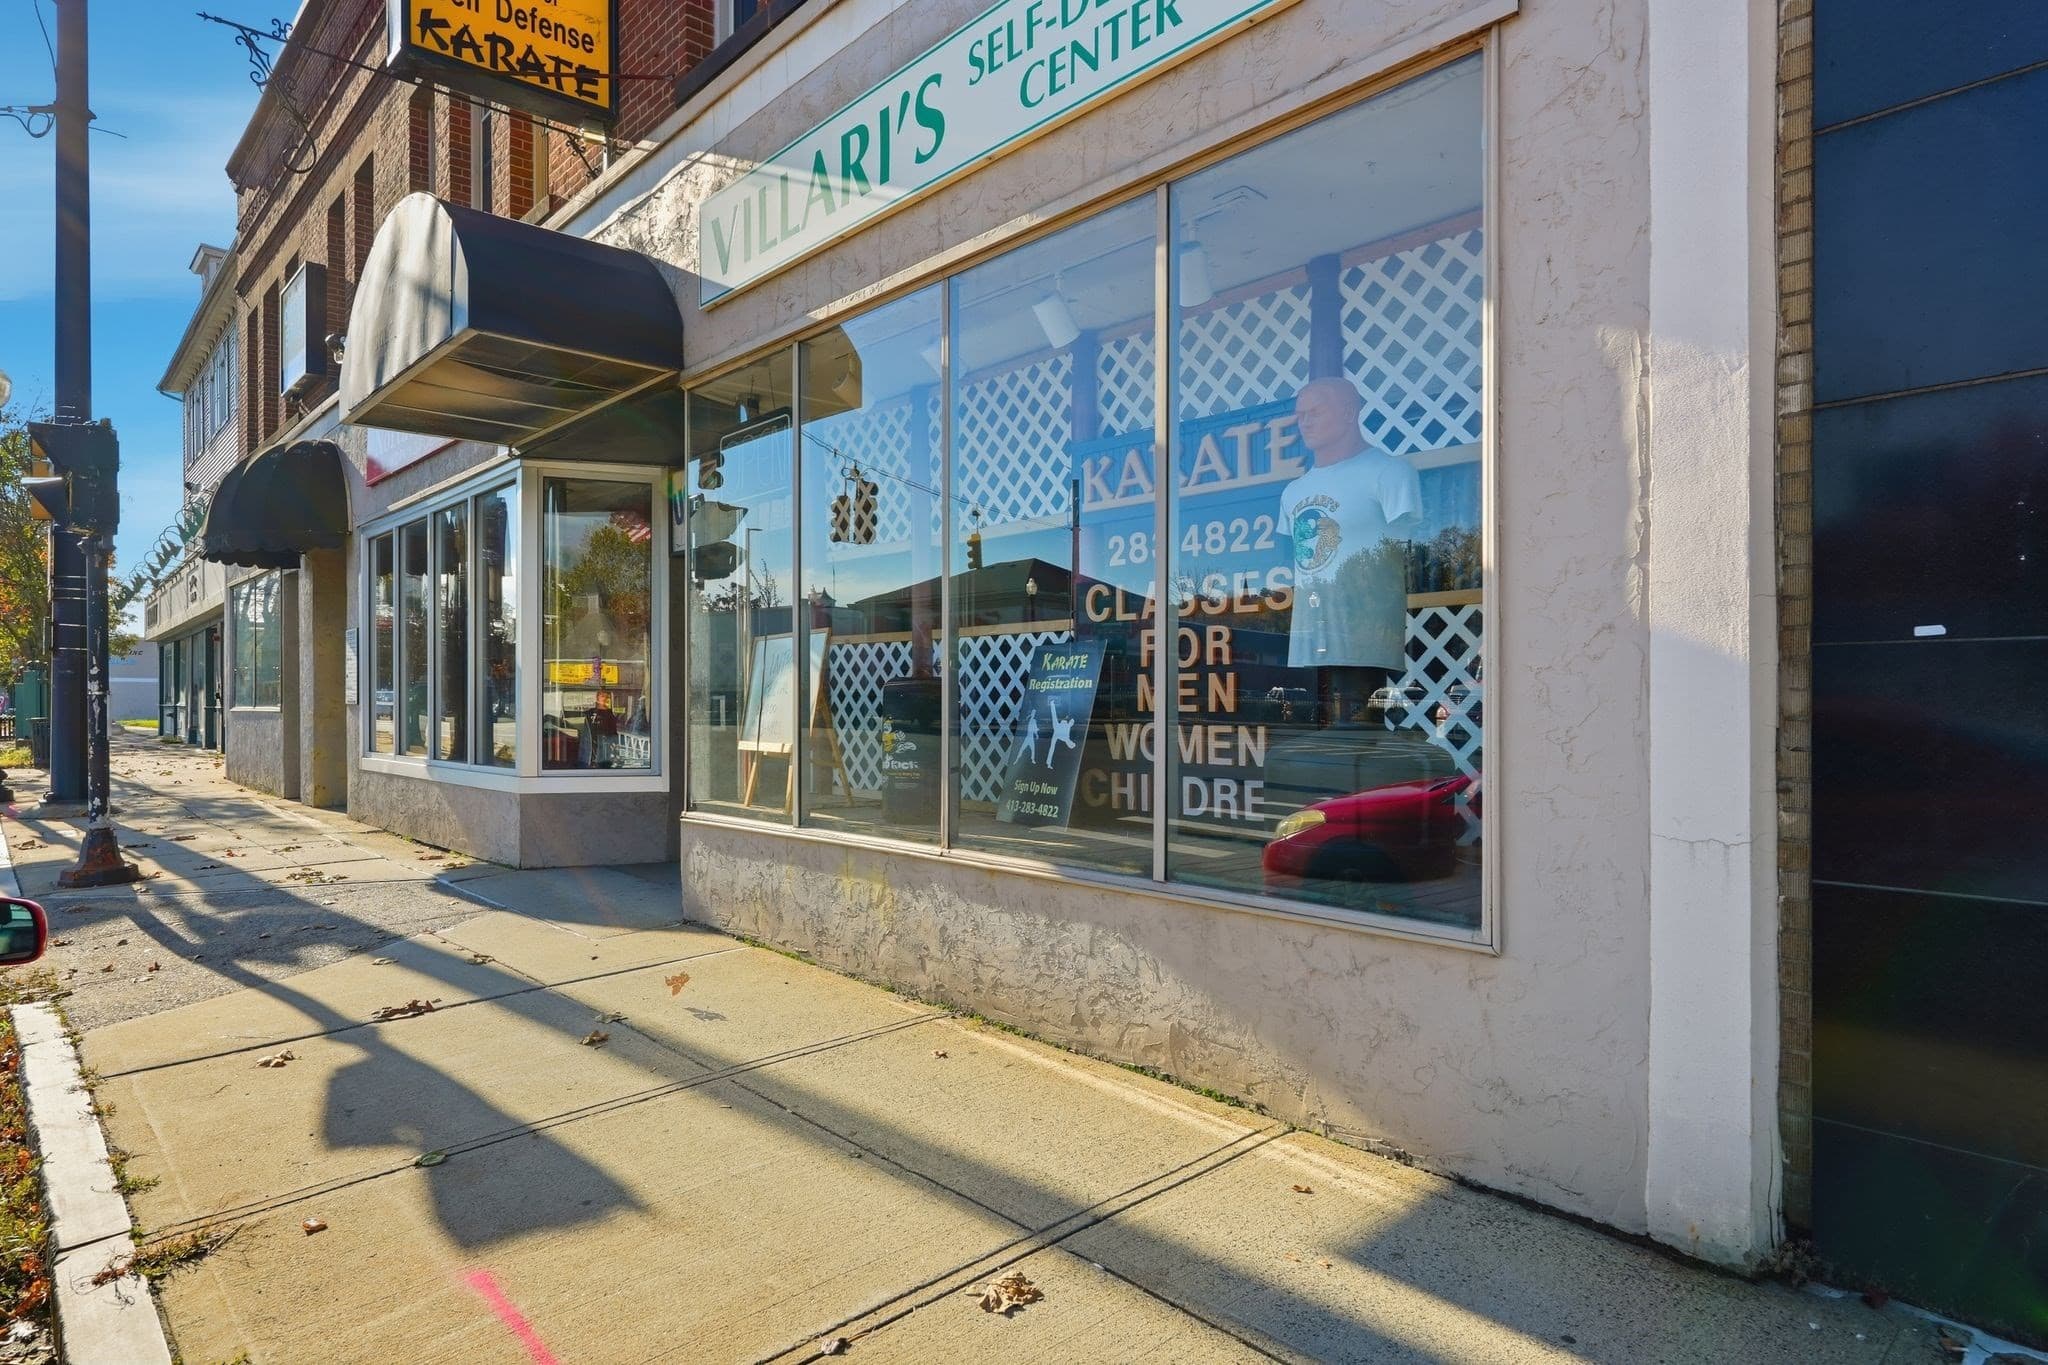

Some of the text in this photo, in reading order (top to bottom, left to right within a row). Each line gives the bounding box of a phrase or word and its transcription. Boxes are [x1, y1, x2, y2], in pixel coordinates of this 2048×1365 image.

[496, 0, 594, 53] Defense
[968, 0, 1110, 86] SELF-D
[417, 8, 601, 100] KARATE
[1019, 0, 1183, 108] CENTER
[711, 73, 946, 276] VILLARI'S
[1082, 416, 1305, 502] KAATE
[1028, 677, 1093, 693] Registration
[1042, 653, 1088, 671] KARATE
[1007, 799, 1059, 818] 413-283-4822
[1014, 780, 1059, 796] Sign Up Now
[1081, 768, 1265, 821] CHIDRE
